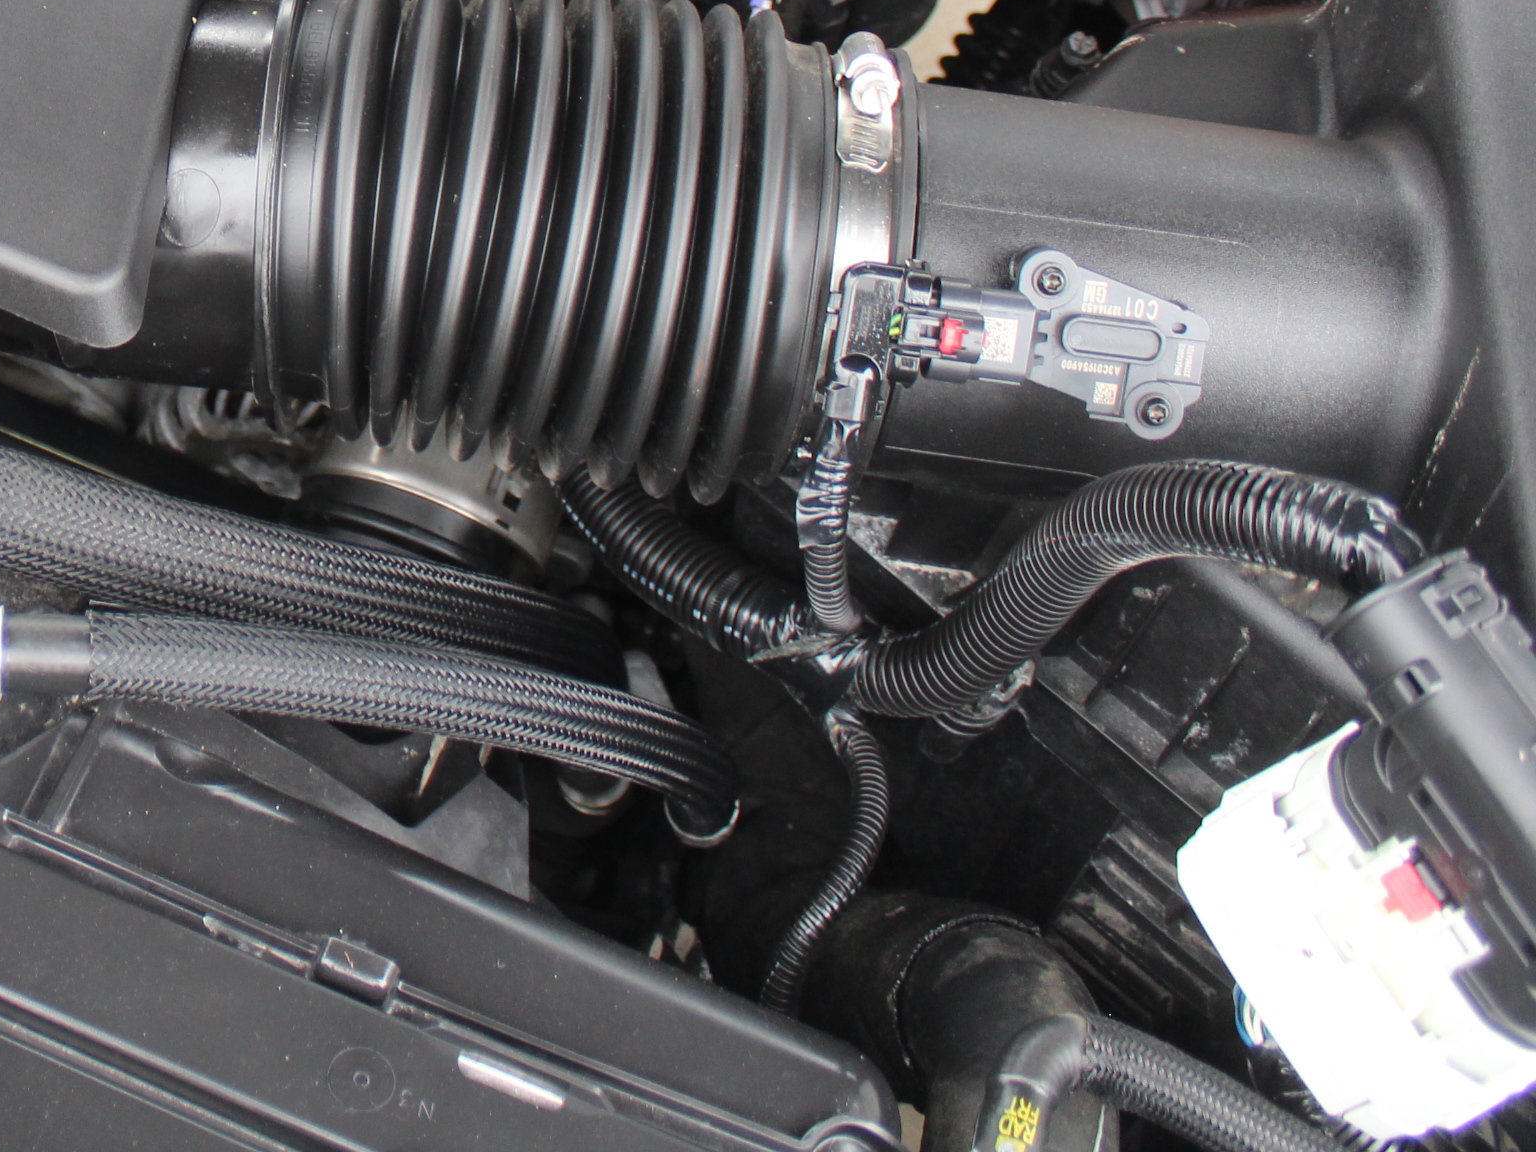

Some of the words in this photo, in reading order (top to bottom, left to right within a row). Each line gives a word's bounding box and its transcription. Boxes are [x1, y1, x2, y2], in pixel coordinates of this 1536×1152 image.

[1083, 281, 1109, 303] GM
[1124, 297, 1159, 320] C01
[1004, 1096, 1040, 1126] FRT
[998, 1114, 1037, 1145] RAD
